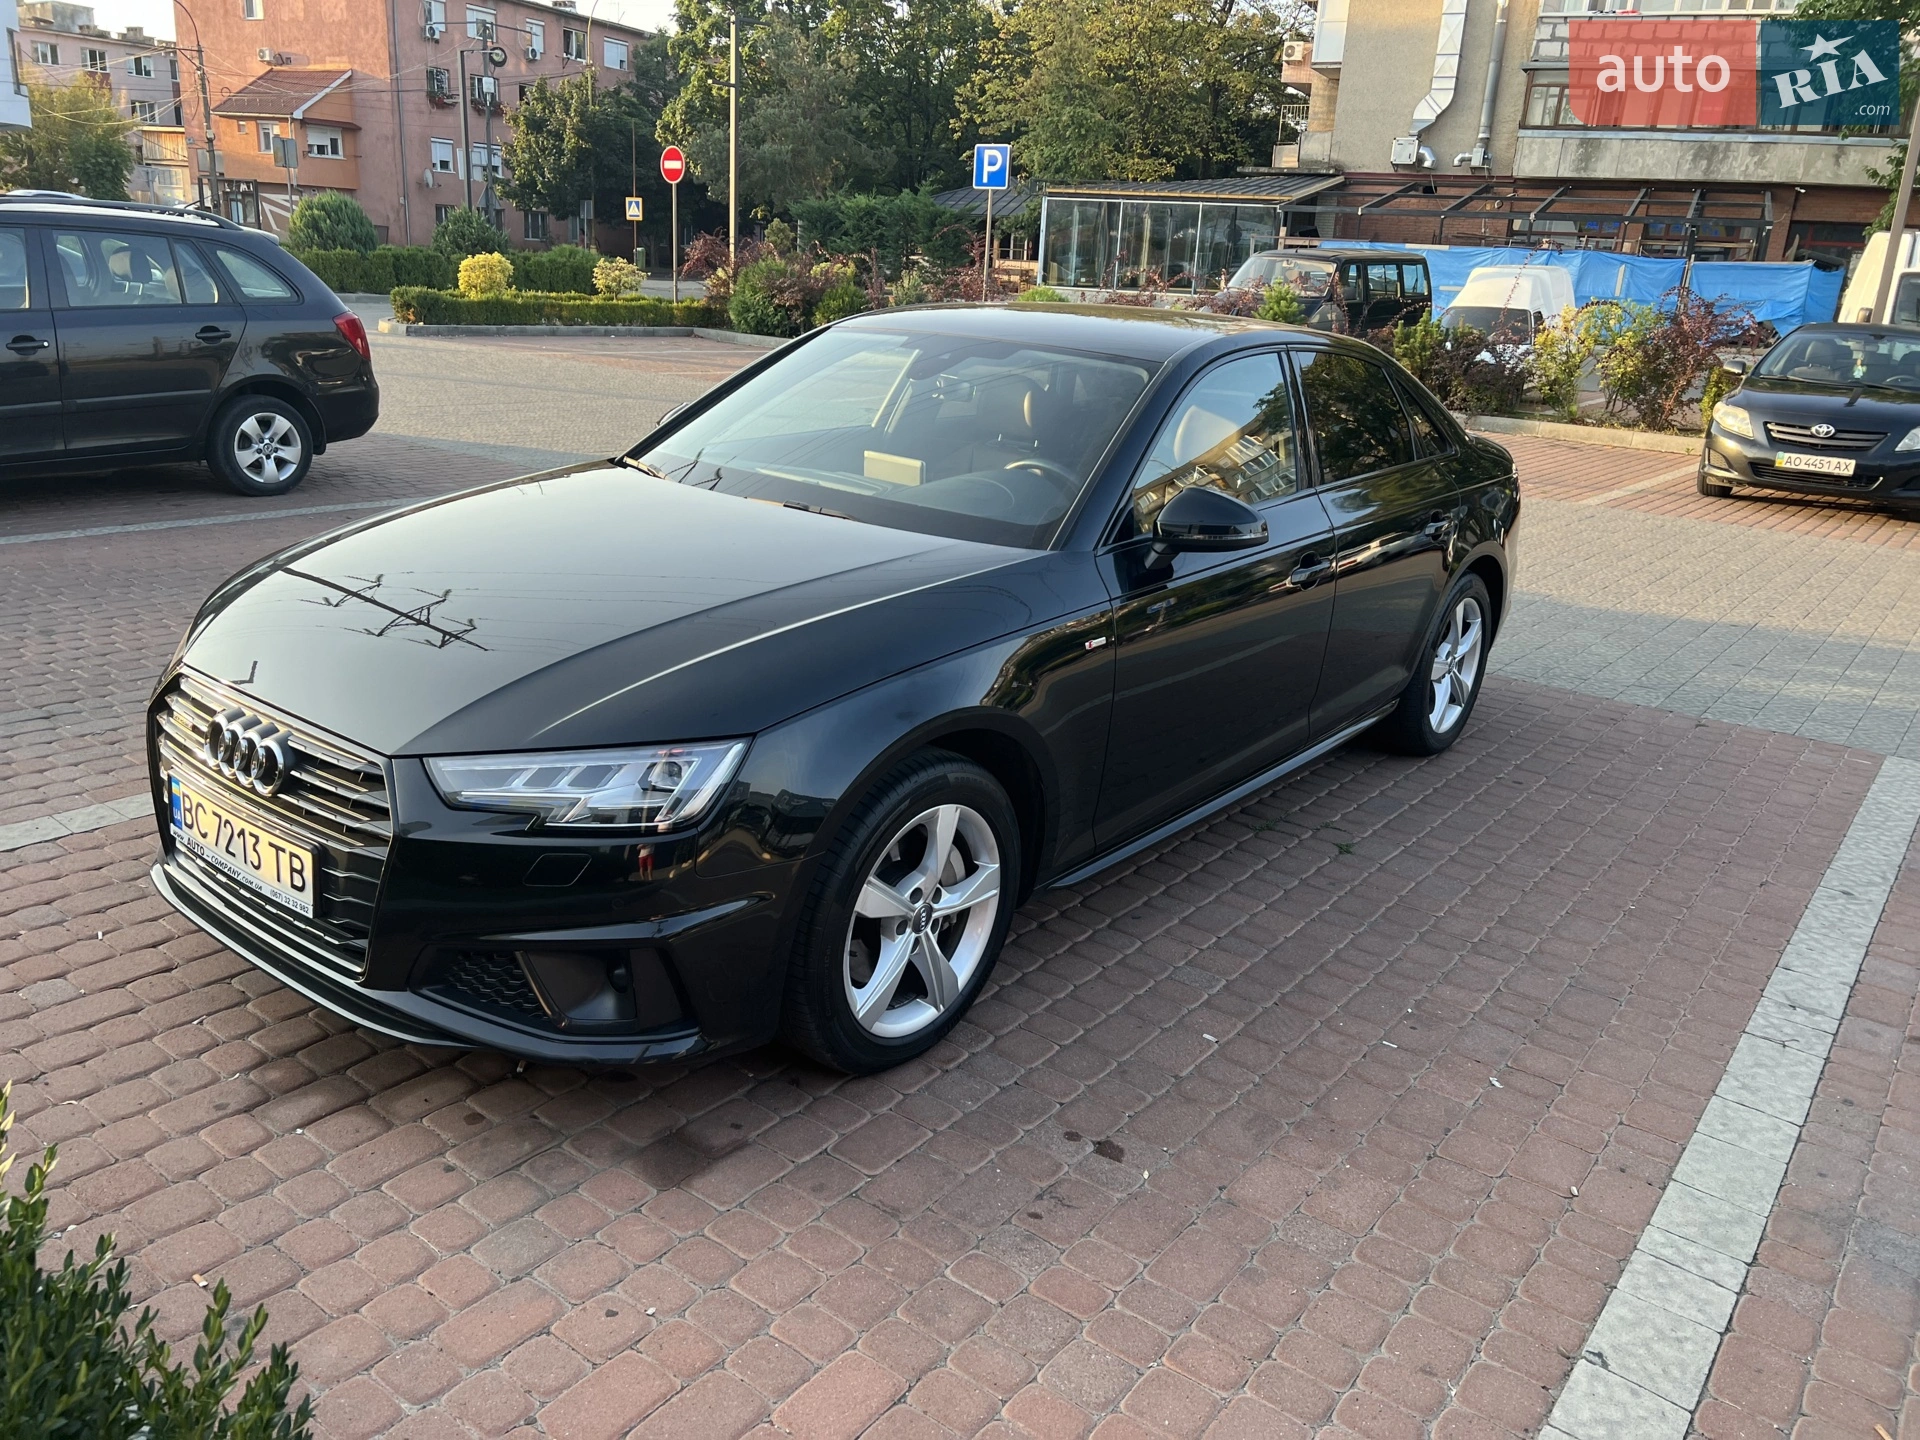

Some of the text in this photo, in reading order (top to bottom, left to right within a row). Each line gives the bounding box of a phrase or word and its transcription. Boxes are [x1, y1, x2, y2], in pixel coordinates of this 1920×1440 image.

[983, 149, 1002, 183] P
[1784, 456, 1852, 472] AO 4451 AX
[173, 807, 182, 822] UA
[182, 791, 306, 893] BC 7213 TB
